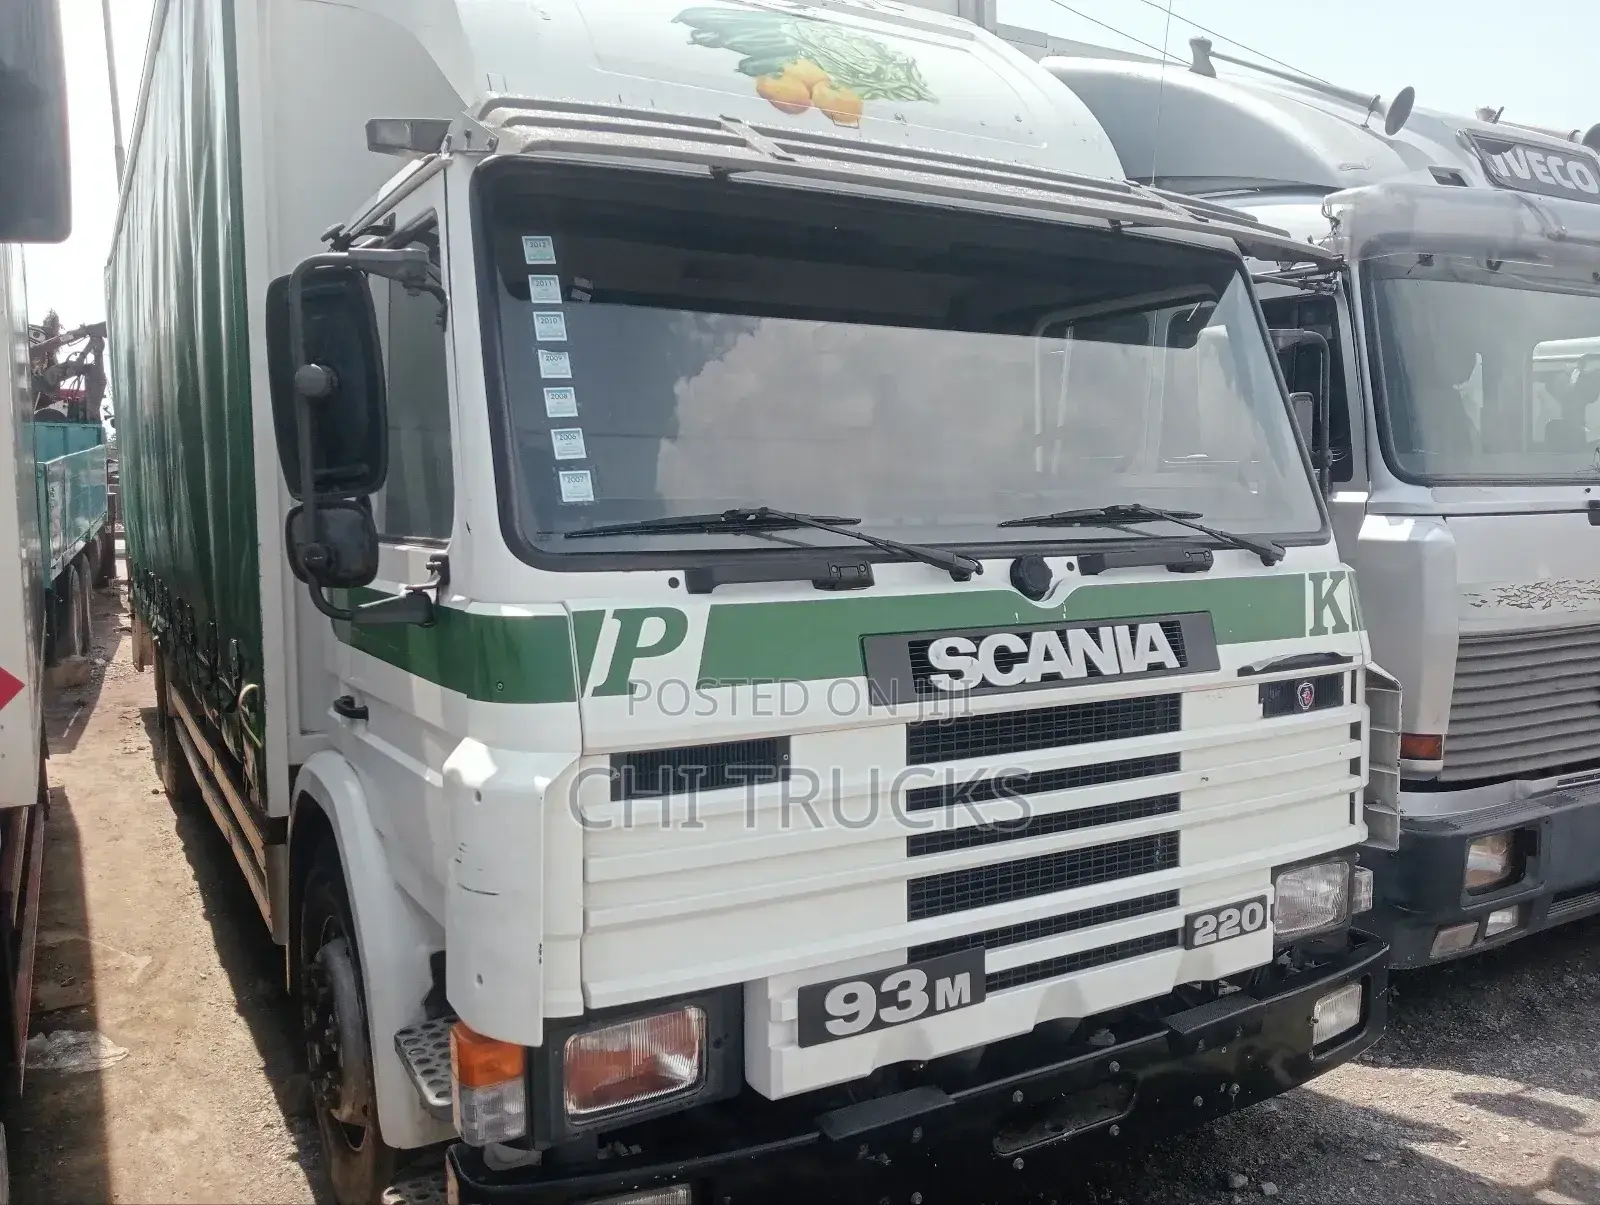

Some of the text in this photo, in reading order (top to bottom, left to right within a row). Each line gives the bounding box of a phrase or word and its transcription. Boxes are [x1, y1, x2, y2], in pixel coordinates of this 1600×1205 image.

[1491, 146, 1599, 194] IVECO
[1308, 571, 1350, 637] K
[591, 607, 689, 697] P
[926, 622, 1180, 692] SCANIA
[1193, 902, 1264, 946] 220
